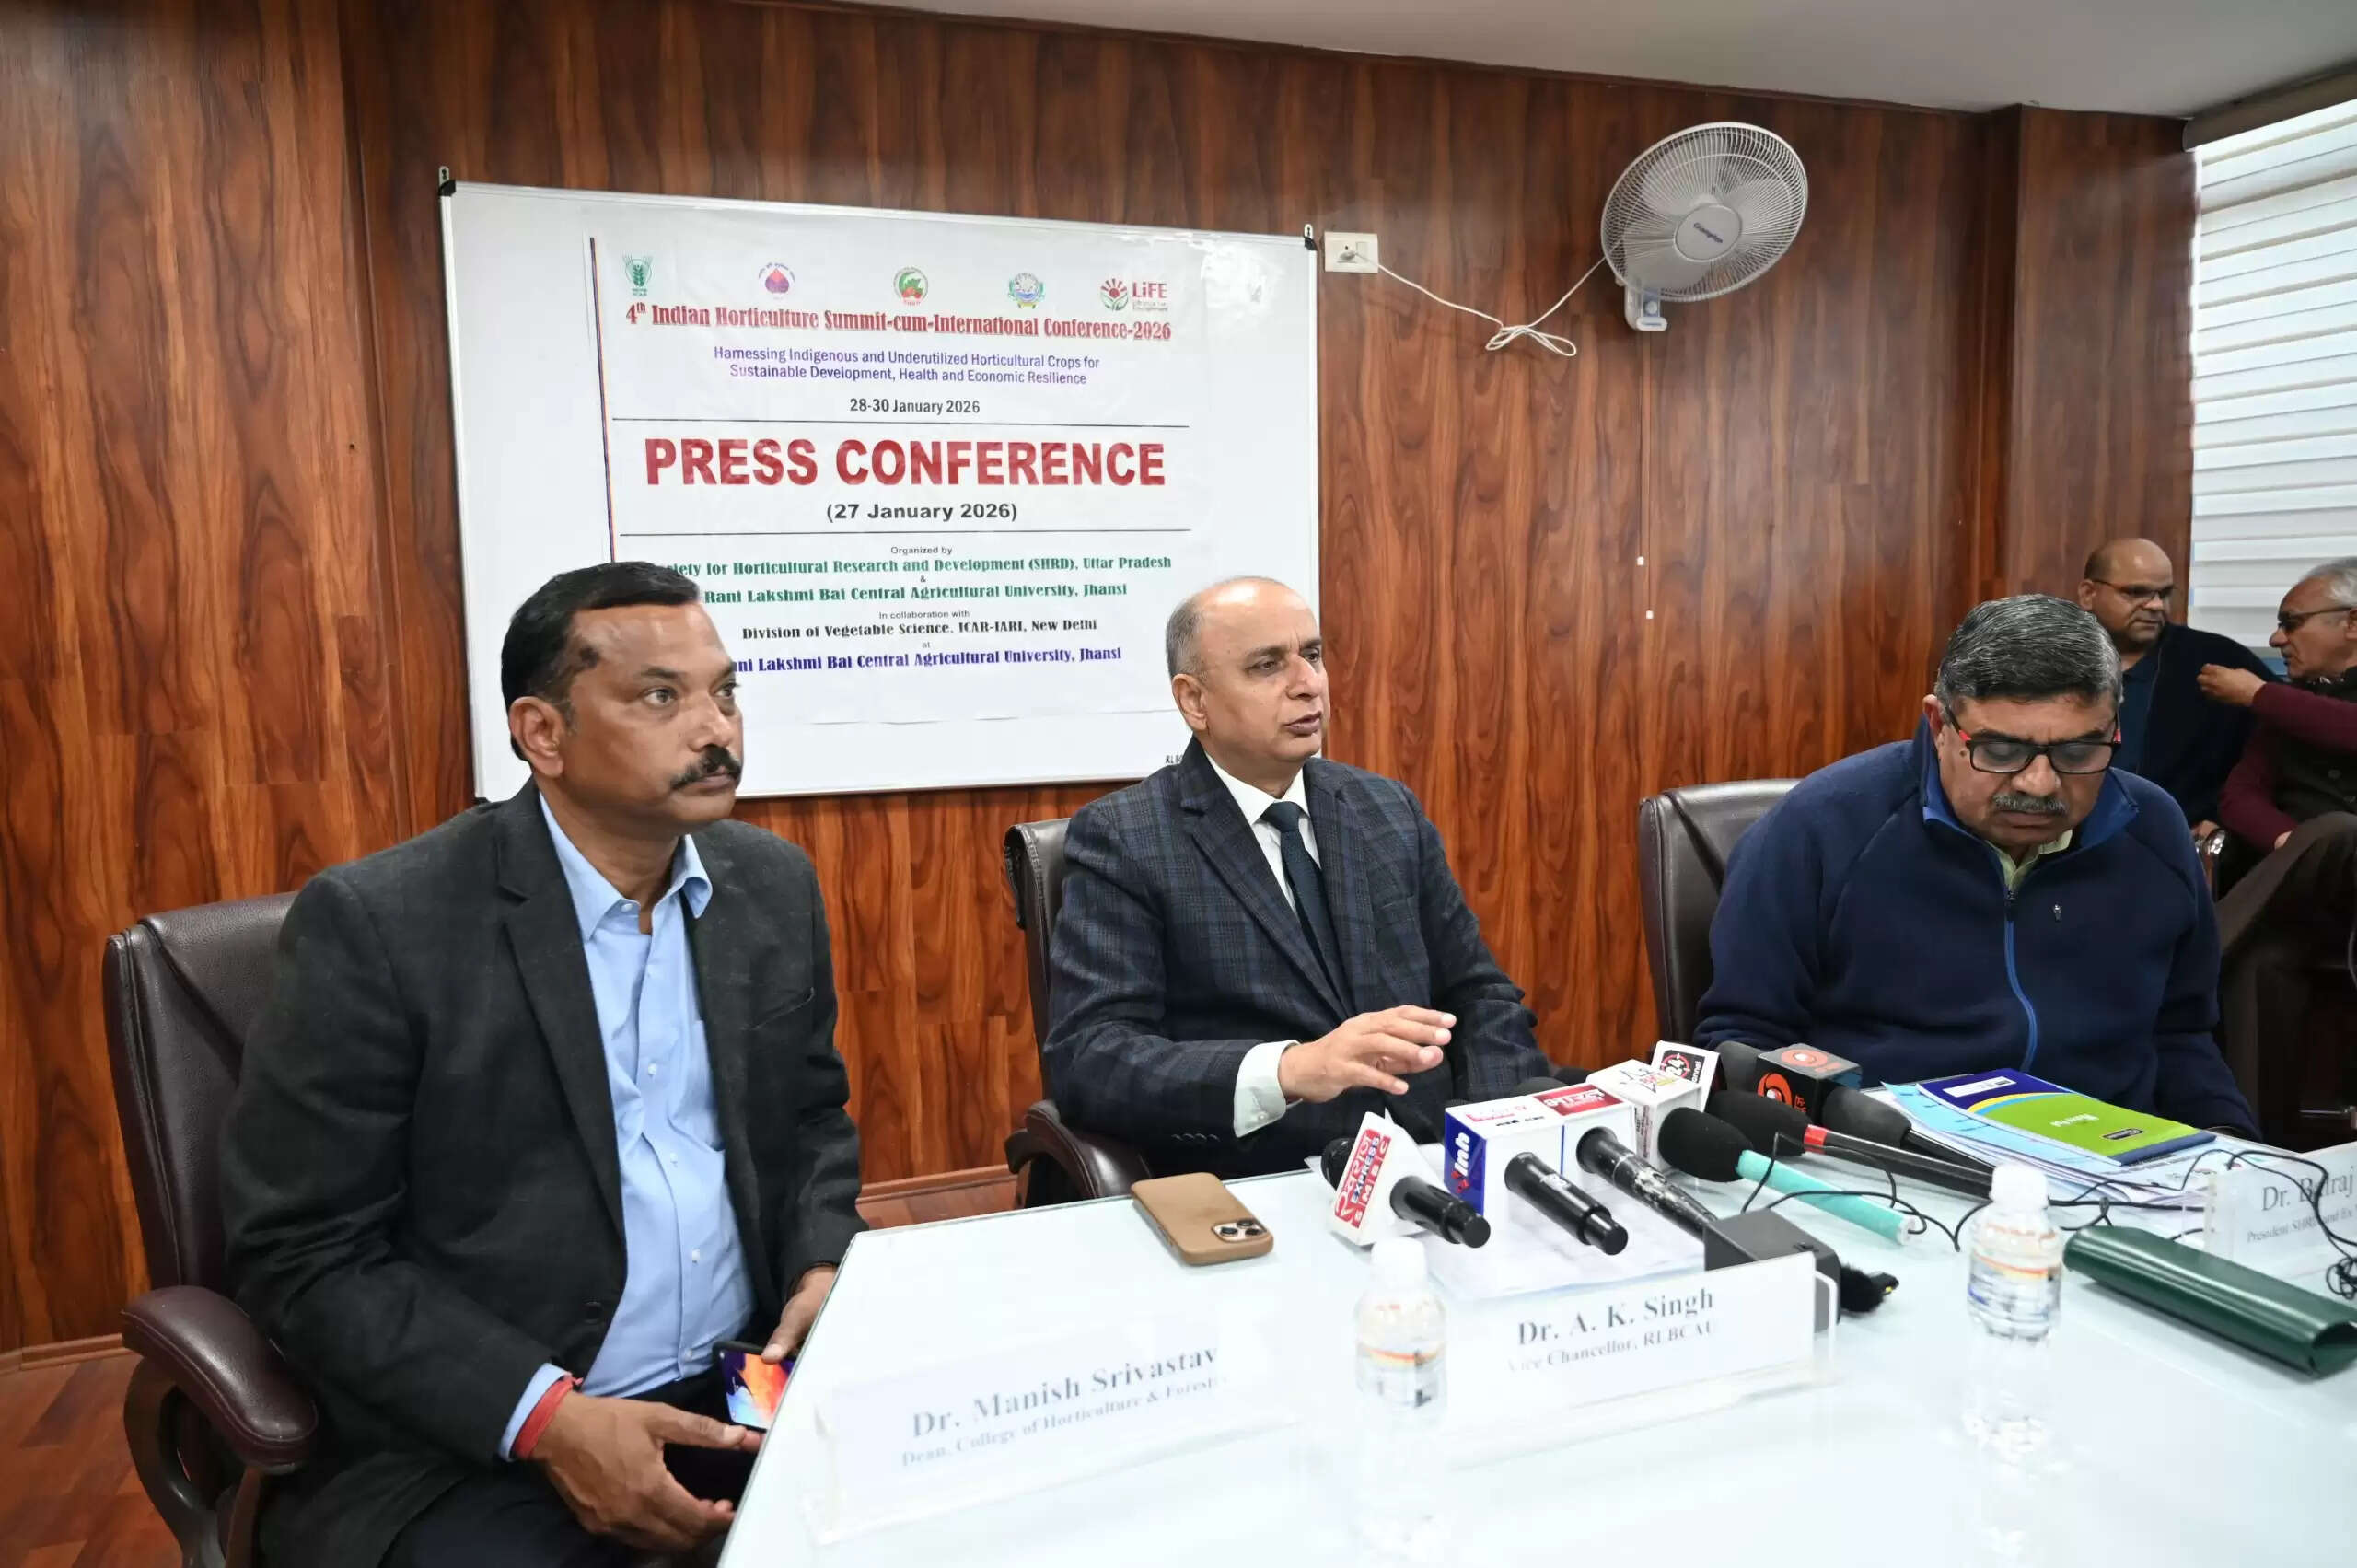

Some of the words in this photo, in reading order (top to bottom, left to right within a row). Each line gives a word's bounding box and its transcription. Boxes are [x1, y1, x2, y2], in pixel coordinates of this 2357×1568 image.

[1132, 282, 1167, 298] LiFE
[652, 305, 710, 327] Indian
[715, 307, 819, 329] Horticulture
[824, 311, 1039, 336] Summit-cum-International
[1044, 317, 1171, 341] Conference-2026
[714, 346, 785, 364] Harnessing
[789, 348, 858, 365] Indigenous
[862, 351, 884, 363] and
[888, 351, 968, 365] Underutilized
[971, 354, 1044, 367] Horticultural
[1047, 355, 1081, 370] Crops
[1084, 356, 1099, 368] for
[730, 364, 807, 378] Sustainable
[810, 366, 896, 383] Development,
[900, 368, 938, 381] Health
[942, 369, 964, 381] and
[968, 369, 1025, 383] Economic
[1028, 370, 1086, 384] Resilience
[850, 398, 889, 412] 28-30
[893, 399, 943, 415] January
[946, 400, 980, 413] 2026
[645, 439, 818, 485] PRESS
[836, 439, 1165, 486] CONFERENCE
[827, 504, 859, 523] (27
[867, 504, 953, 522] January
[960, 504, 1016, 521] 2026)
[890, 546, 938, 555] Organized
[941, 546, 952, 555] by
[707, 563, 728, 575] for
[733, 561, 828, 575] Horticultural
[833, 560, 898, 573] Research
[902, 560, 929, 572] and
[935, 559, 1024, 572] Development
[1028, 558, 1078, 571] (SHRD),
[1083, 558, 1114, 569] Uttar
[1119, 557, 1171, 569] Pradesh
[705, 591, 741, 603] Rani
[748, 589, 814, 602] Lakshmi
[819, 588, 845, 600] Bai
[851, 587, 905, 600] Central
[911, 586, 999, 600] Agricultural
[1005, 585, 1078, 597] University,
[1084, 584, 1127, 597] Jhansi
[951, 610, 970, 619] with
[743, 627, 800, 639] Division
[806, 626, 819, 637] of
[825, 624, 894, 638] Vegetable
[1032, 621, 1058, 631] New
[1063, 620, 1097, 630] Delhi
[732, 659, 753, 672] ni
[759, 656, 821, 671] Lakshmi
[828, 656, 852, 668] Bai
[857, 654, 909, 668] Central
[915, 651, 999, 667] Agricultural
[1004, 649, 1074, 663] University,
[1080, 647, 1121, 662] Jhansi
[2262, 1186, 2290, 1211] Dr.
[2300, 1166, 2354, 1202] Blraj
[1519, 1321, 1559, 1345] Dr.
[1569, 1312, 1596, 1336] A.
[1608, 1304, 1634, 1328] K.
[1643, 1288, 1713, 1321] Singh
[1548, 1338, 1637, 1365] Chancellor,
[913, 1411, 960, 1437] Dr.
[973, 1377, 1080, 1420] Manish
[1091, 1347, 1217, 1392] Srivastav
[957, 1427, 1015, 1452] College
[1023, 1418, 1039, 1435] of
[1043, 1396, 1142, 1429] Horticulture
[1147, 1390, 1158, 1403] &
